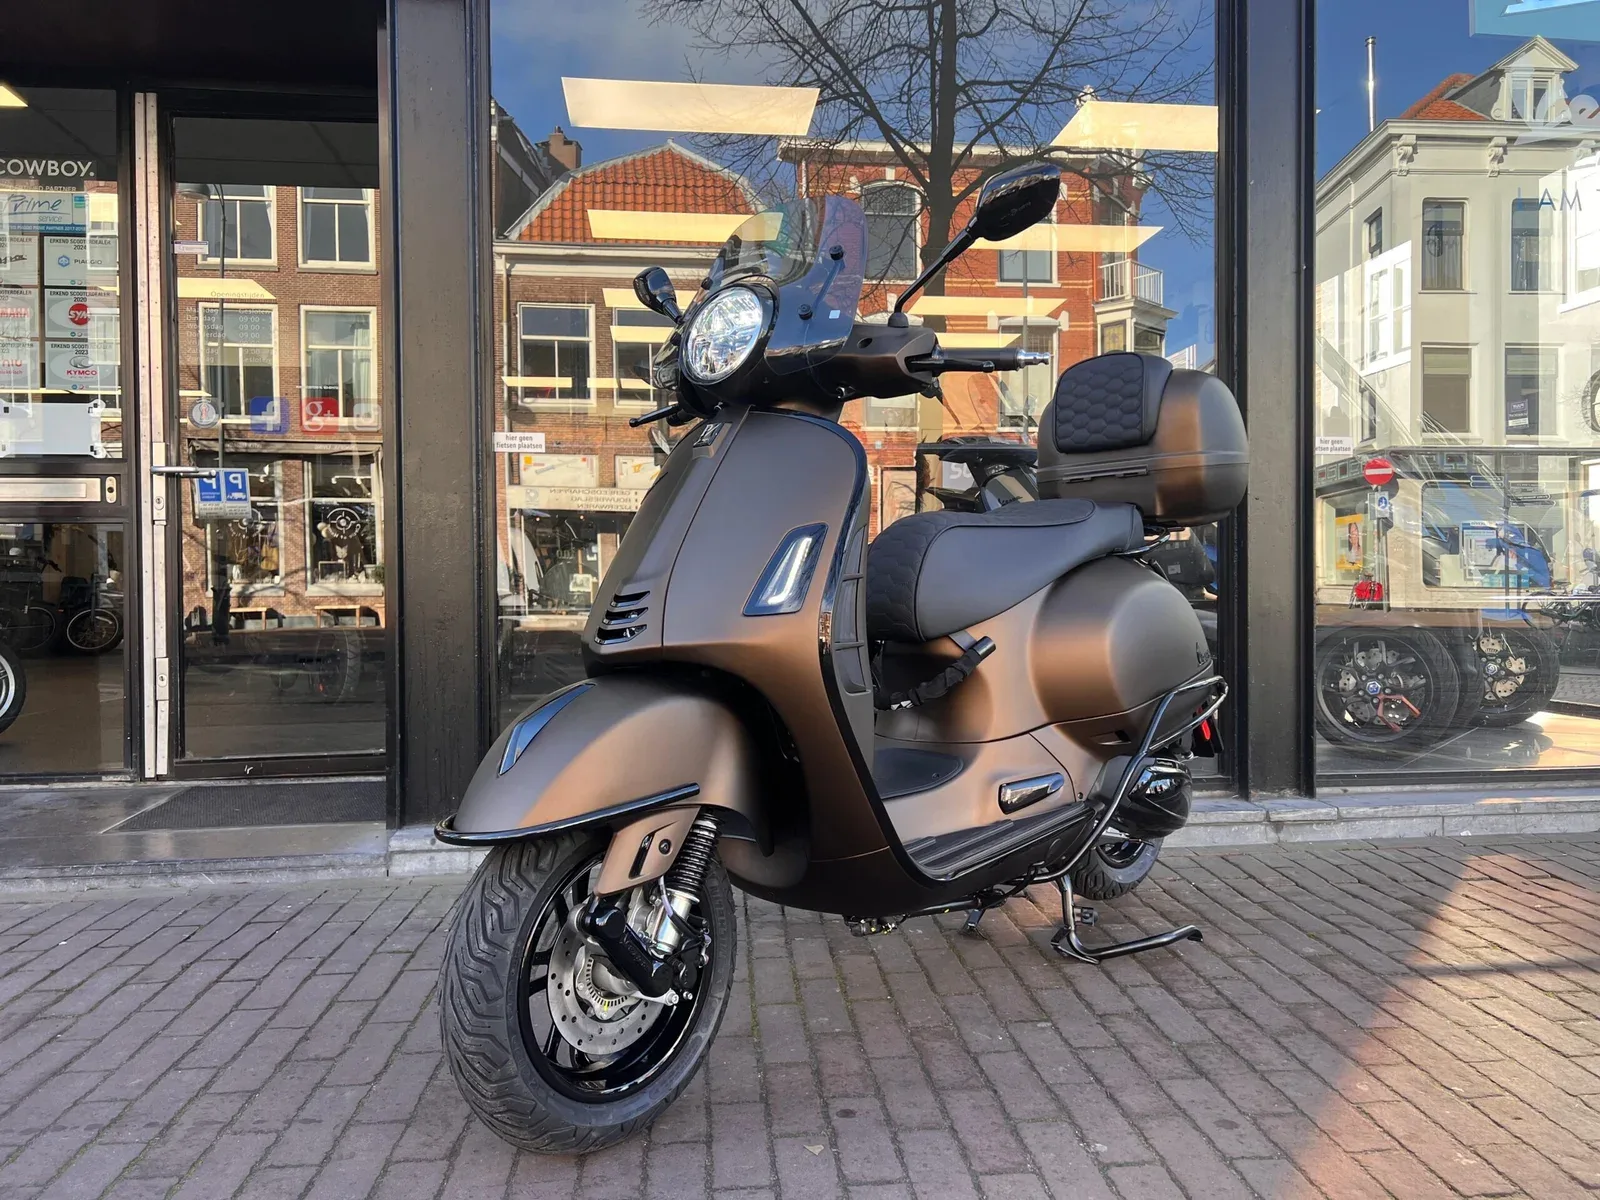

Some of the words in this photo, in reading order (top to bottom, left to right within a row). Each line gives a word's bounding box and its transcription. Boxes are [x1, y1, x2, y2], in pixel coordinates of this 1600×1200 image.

[6, 193, 63, 212] Prime
[37, 215, 63, 223] service
[210, 290, 265, 299] Openingstijden
[518, 442, 543, 450] plaatsen
[1330, 445, 1352, 453] plaatsen
